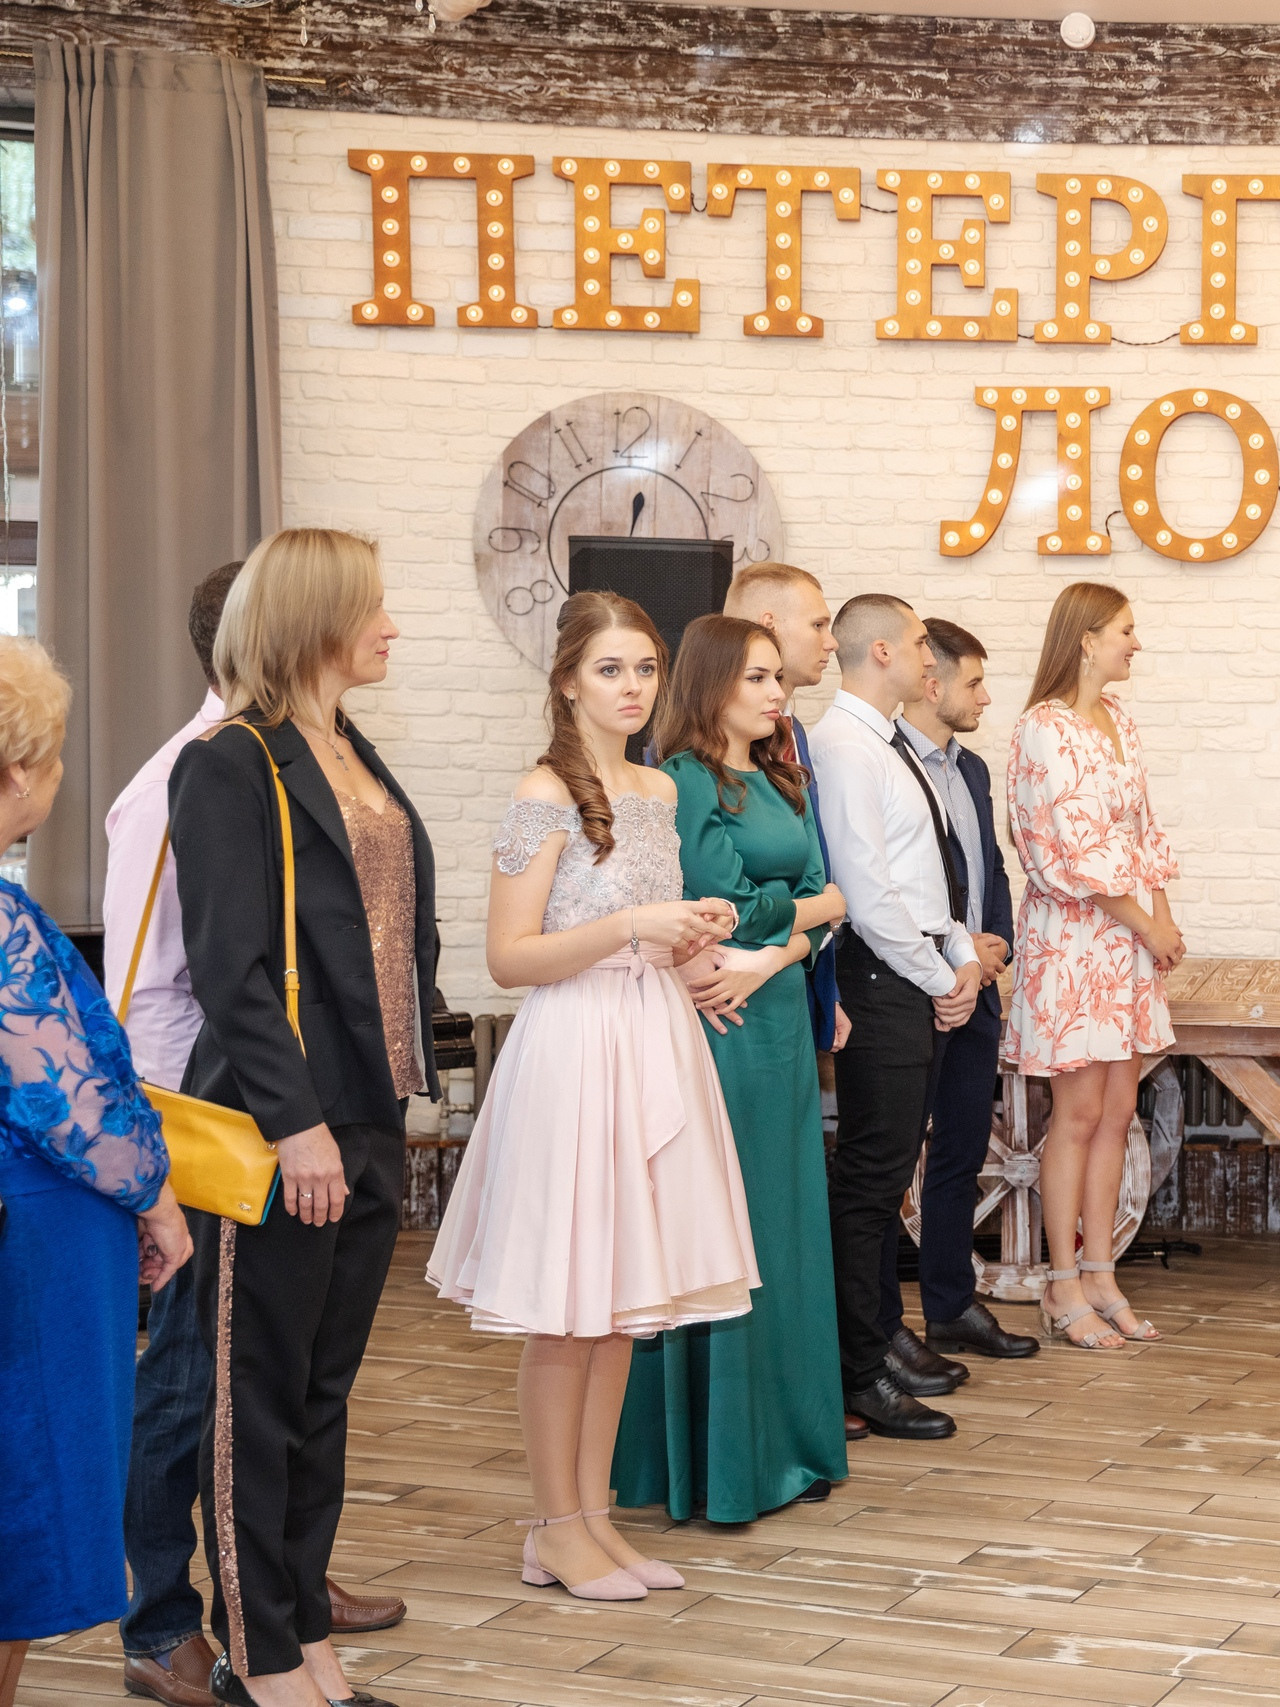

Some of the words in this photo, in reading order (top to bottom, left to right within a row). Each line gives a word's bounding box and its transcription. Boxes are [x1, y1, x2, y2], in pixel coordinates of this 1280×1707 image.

[554, 419, 593, 470] 11
[612, 406, 652, 459] 12
[675, 429, 703, 470] 1
[503, 460, 556, 508] 10
[700, 473, 755, 516] 2
[489, 527, 541, 554] 9
[505, 580, 554, 615] 8
